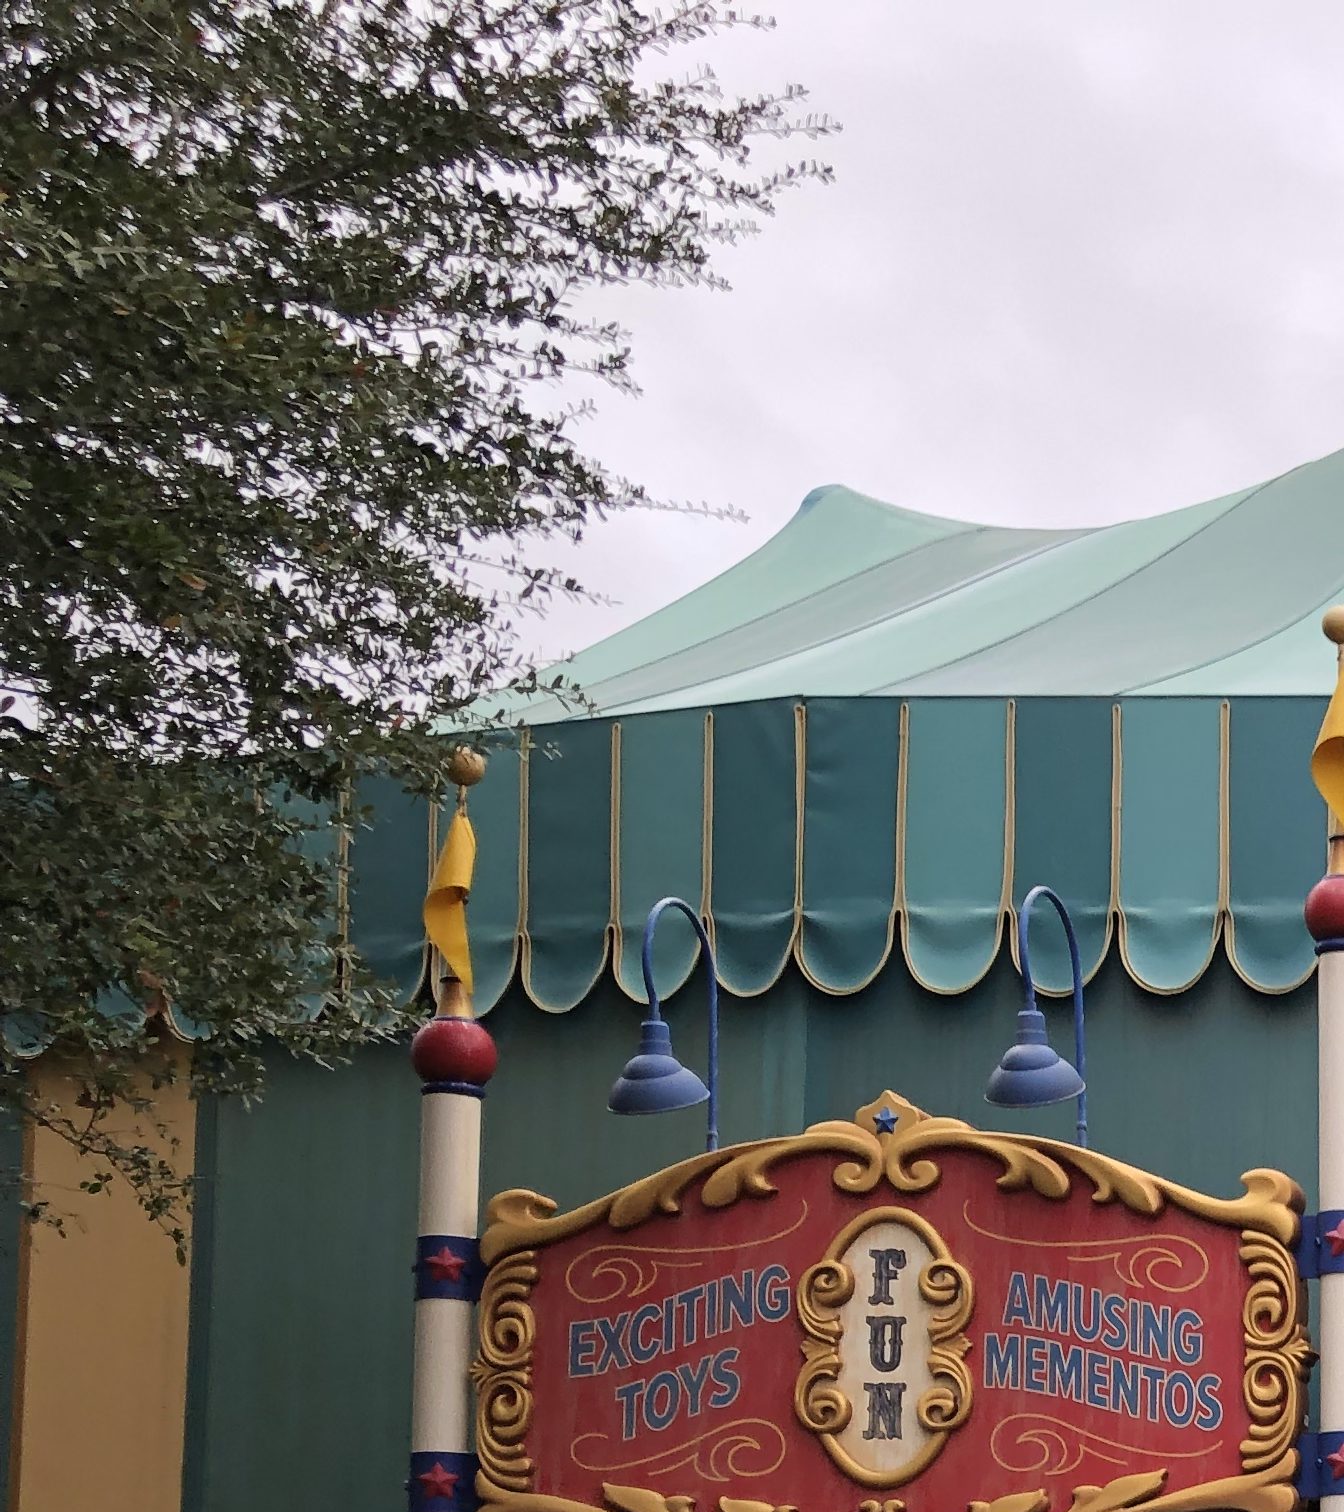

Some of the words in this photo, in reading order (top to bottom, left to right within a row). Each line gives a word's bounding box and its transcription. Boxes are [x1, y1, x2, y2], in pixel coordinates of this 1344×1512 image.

[567, 1264, 791, 1378] EXCITING
[1003, 1271, 1204, 1366] AMUSING
[614, 1348, 741, 1441] TOYS
[983, 1333, 1224, 1432] MEMENTOS
